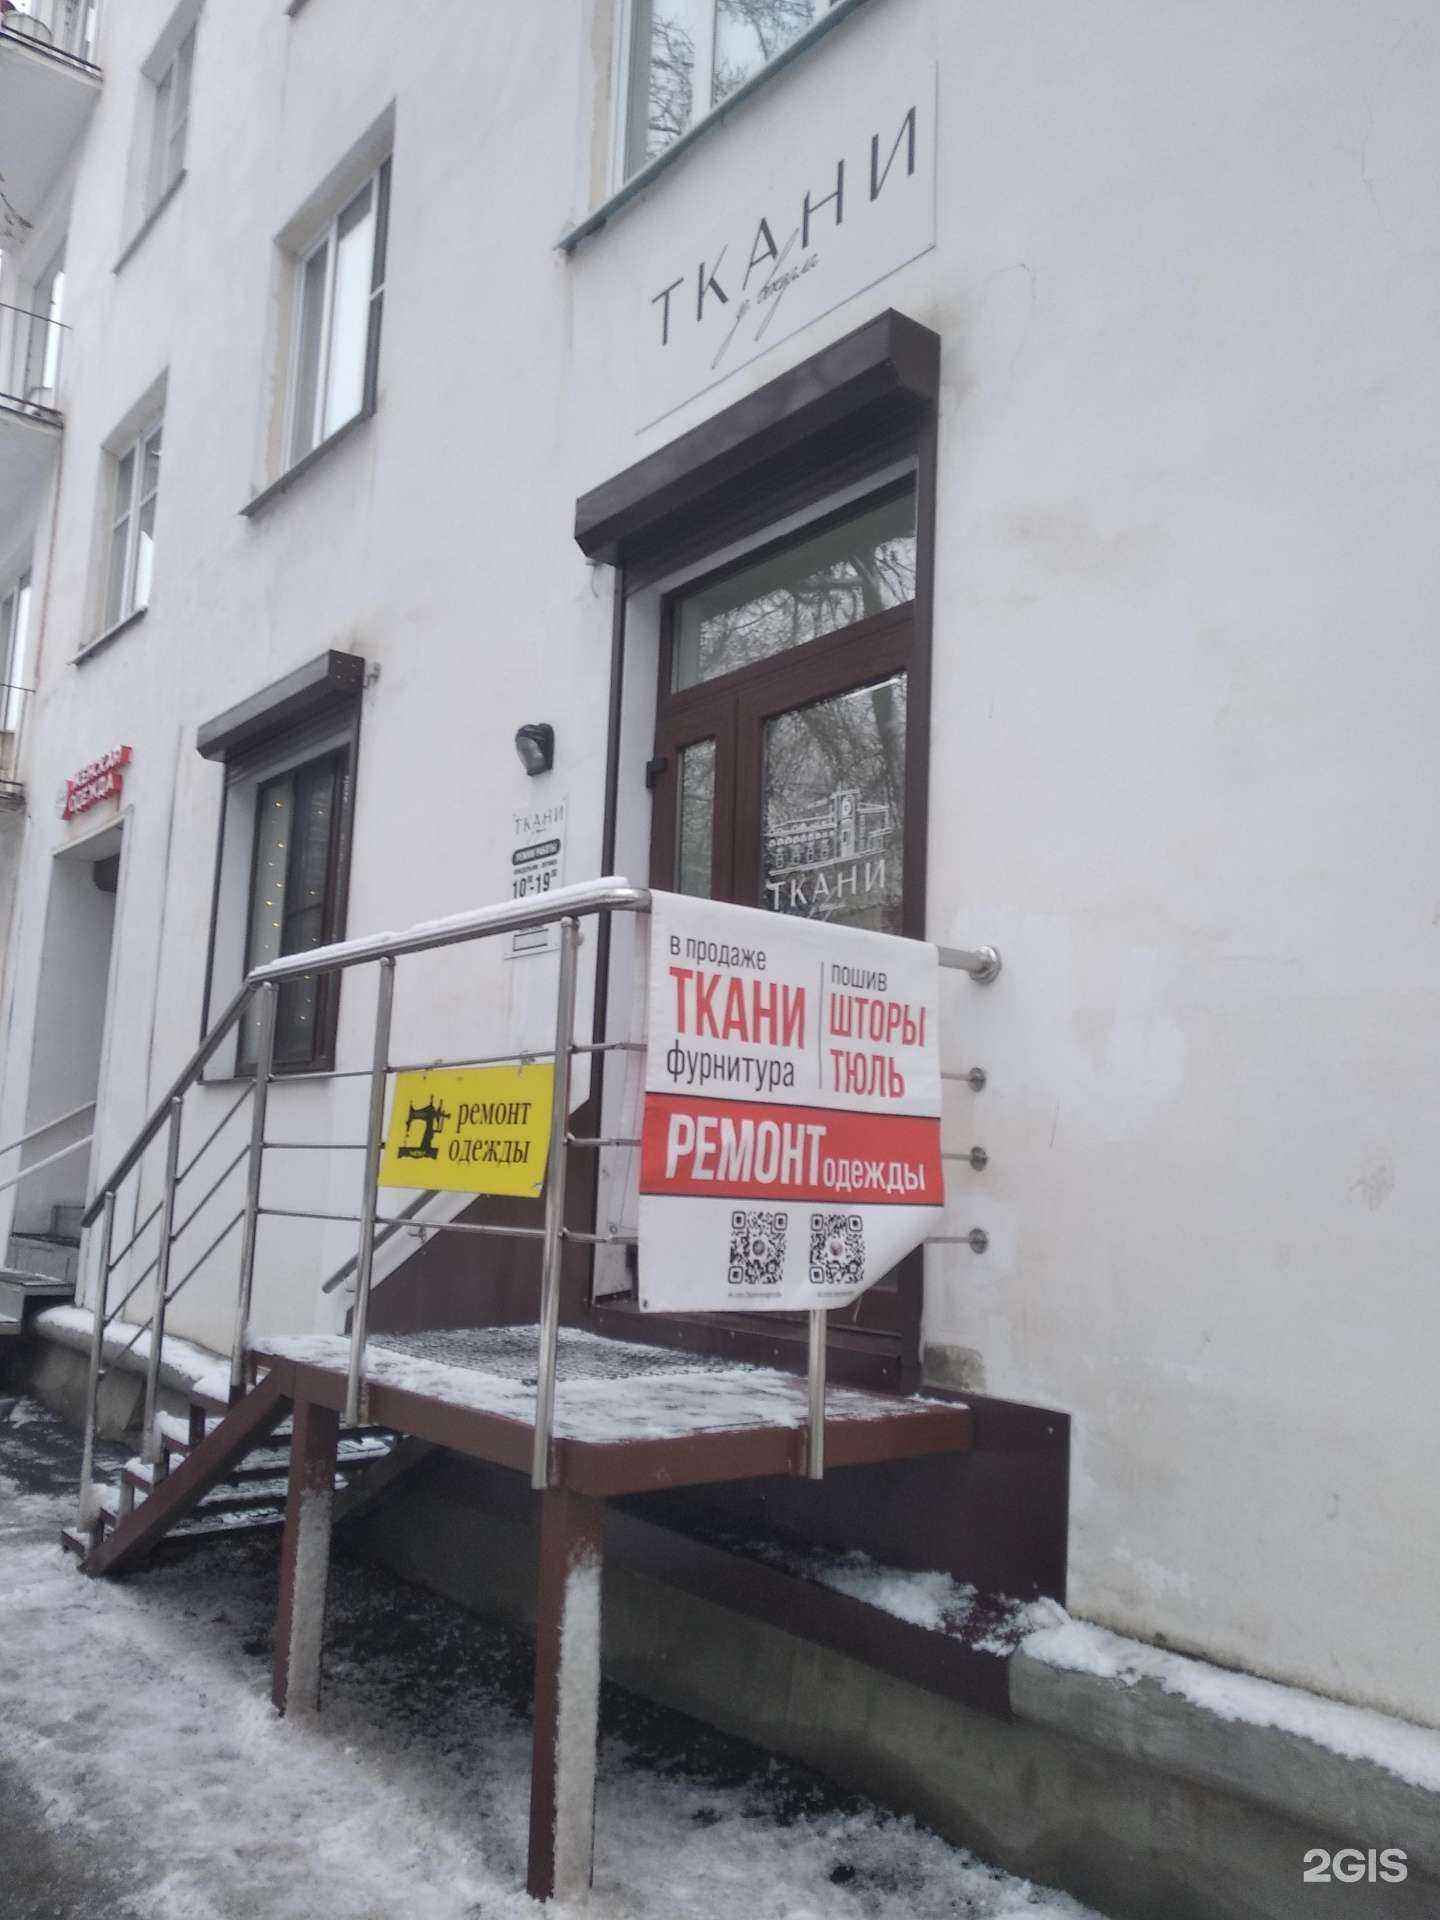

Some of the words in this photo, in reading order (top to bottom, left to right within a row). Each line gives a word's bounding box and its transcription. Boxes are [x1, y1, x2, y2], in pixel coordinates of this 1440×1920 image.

[651, 105, 917, 346] ТКАНИ
[515, 804, 564, 835] ТКАНИ
[766, 859, 886, 910] ТКАНИ
[686, 938, 767, 971] продаже
[831, 964, 888, 992] пошив
[669, 965, 806, 1050] ТКАНИ
[829, 993, 927, 1048] ШТОРЫ
[667, 1039, 795, 1093] фурнитура
[829, 1049, 906, 1099] ТЮЛЬ
[456, 1101, 532, 1134] ремонт
[448, 1139, 531, 1165] одежды
[665, 1112, 827, 1189] РЕМОНТ
[823, 1157, 925, 1194] одежды
